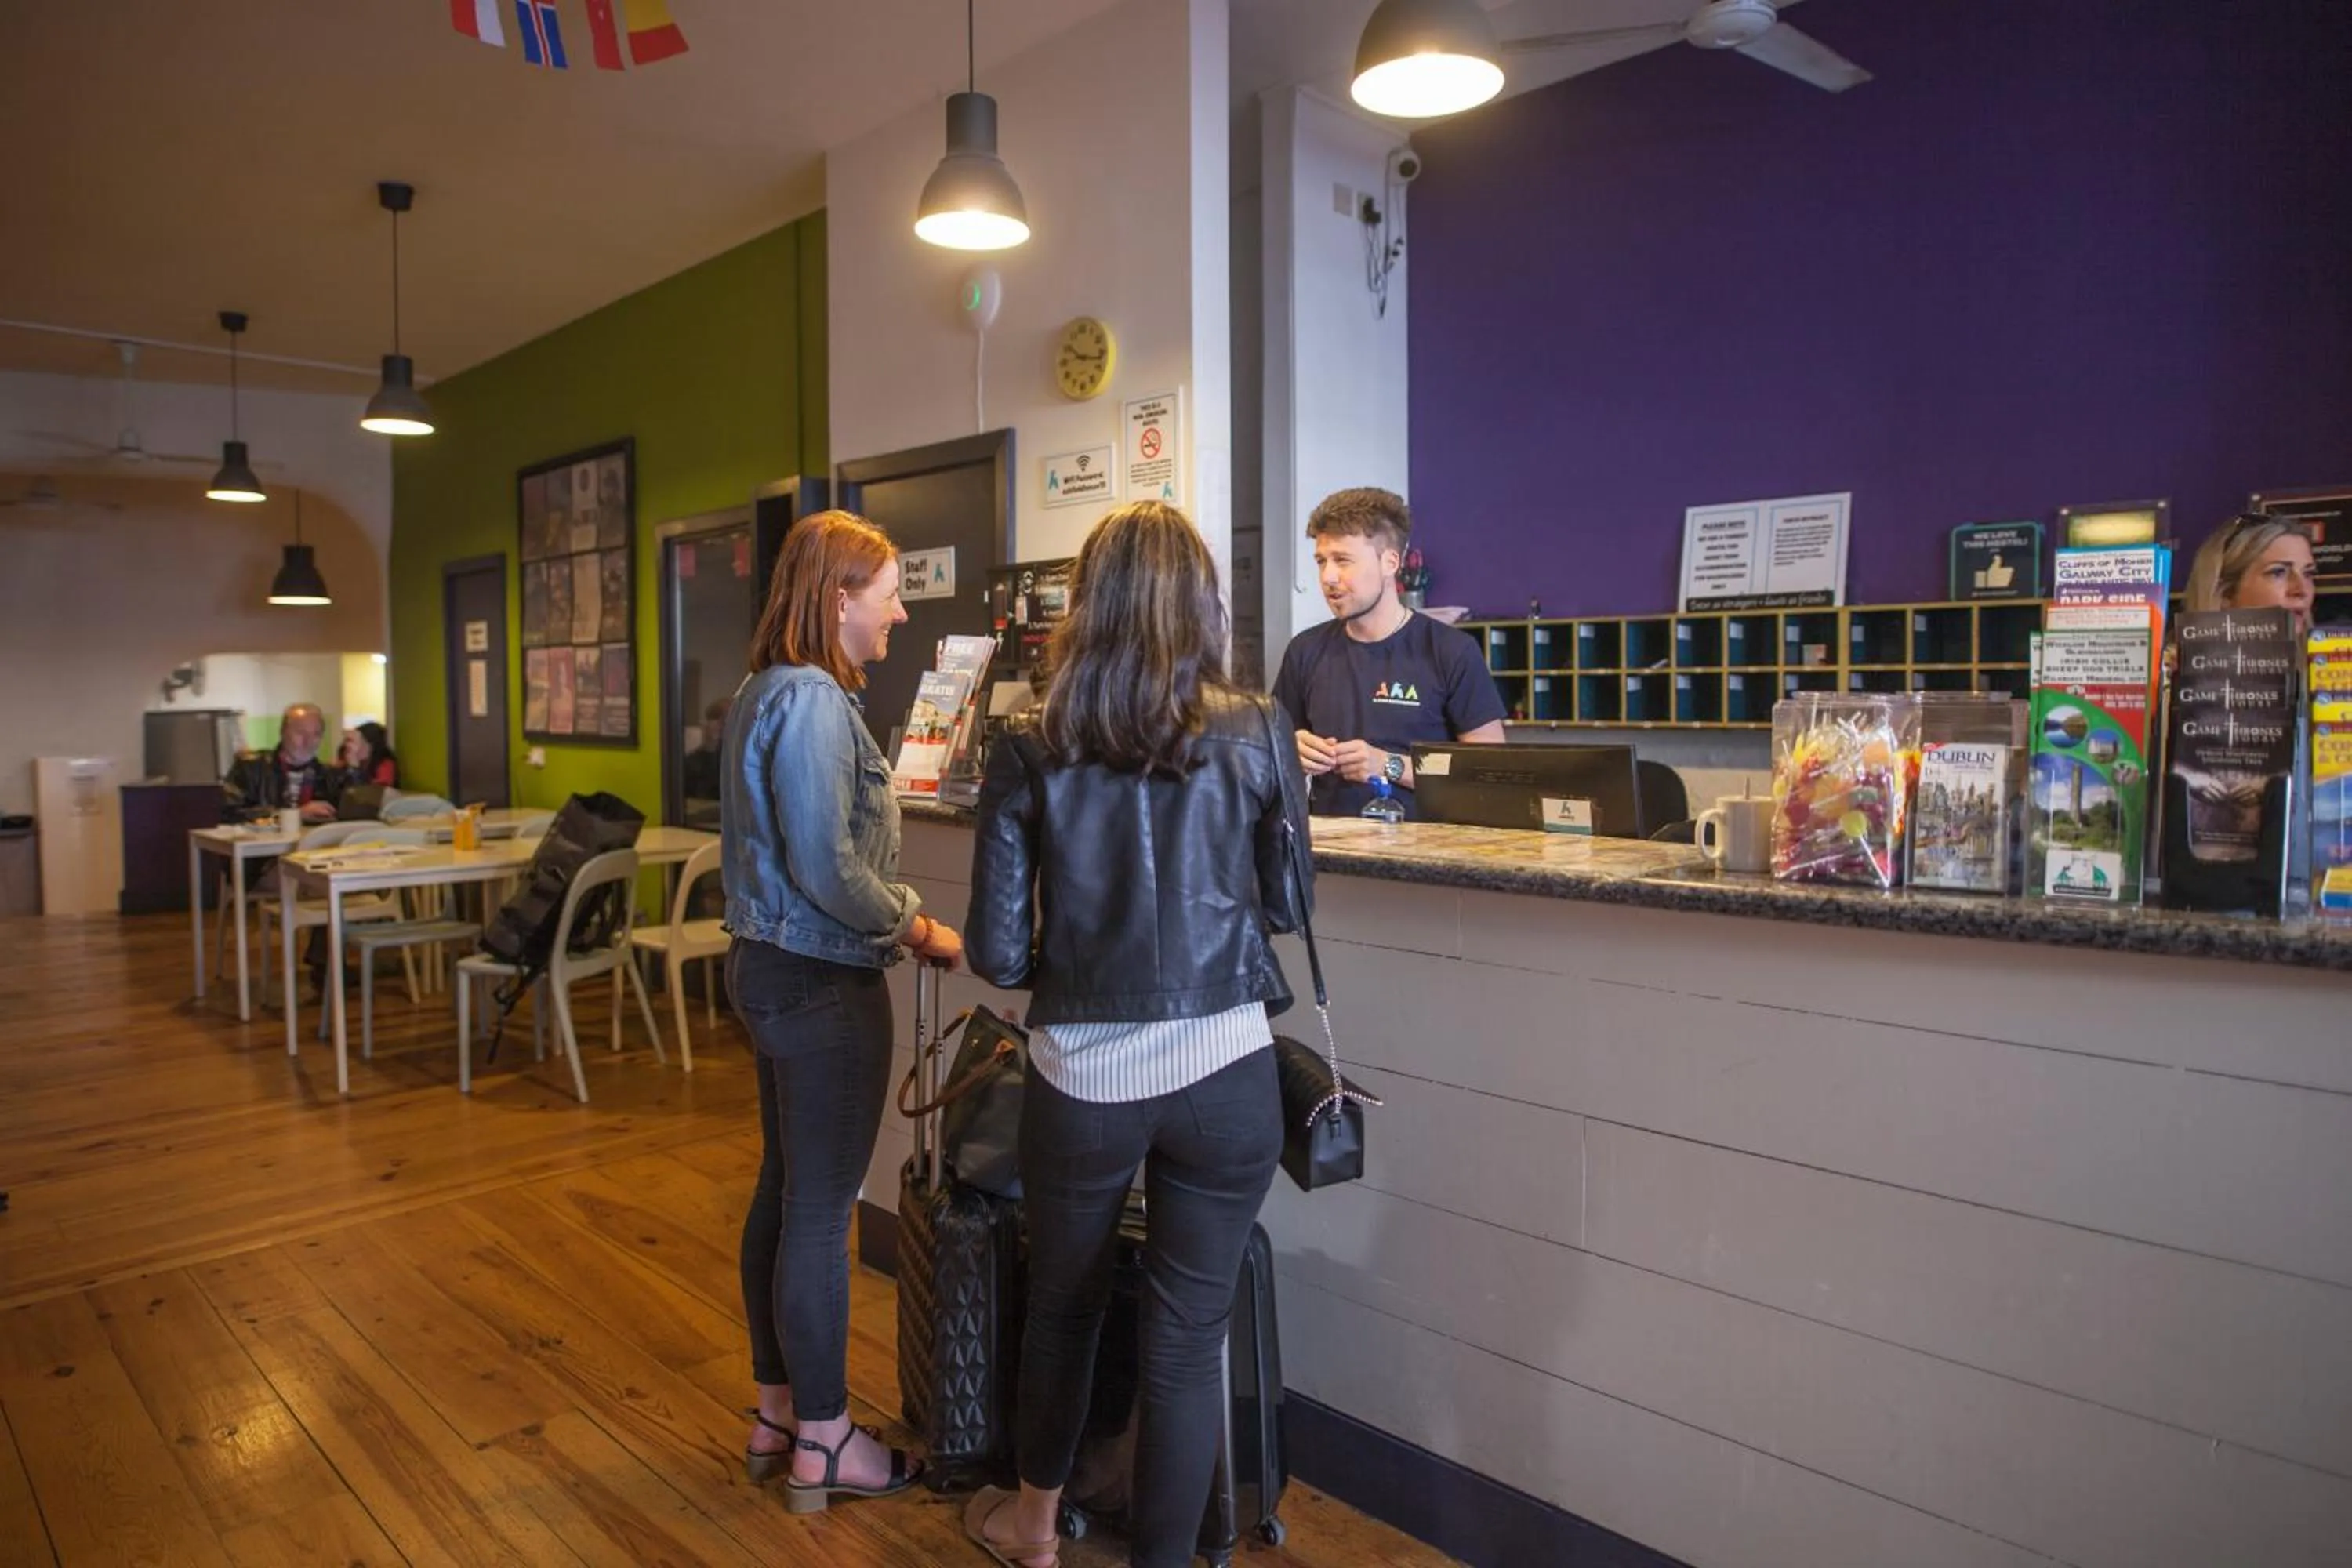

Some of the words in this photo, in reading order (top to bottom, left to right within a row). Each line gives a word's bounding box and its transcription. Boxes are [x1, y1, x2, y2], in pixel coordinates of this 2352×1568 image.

[905, 558, 927, 575] Staff
[2114, 557, 2152, 566] MOHER
[2059, 569, 2113, 579] GALWAY
[2118, 566, 2151, 576] CITY
[906, 575, 927, 594] Only
[2183, 626, 2220, 640] GAME
[2222, 614, 2278, 642] THRONES
[2191, 655, 2228, 669] GAME
[2230, 645, 2289, 676] THRONES
[2180, 688, 2217, 702] GAME
[2220, 678, 2278, 710] THRONES
[2183, 721, 2220, 735] GAME
[2223, 713, 2282, 749] THRONES
[1928, 750, 1995, 764] DUBLIN
